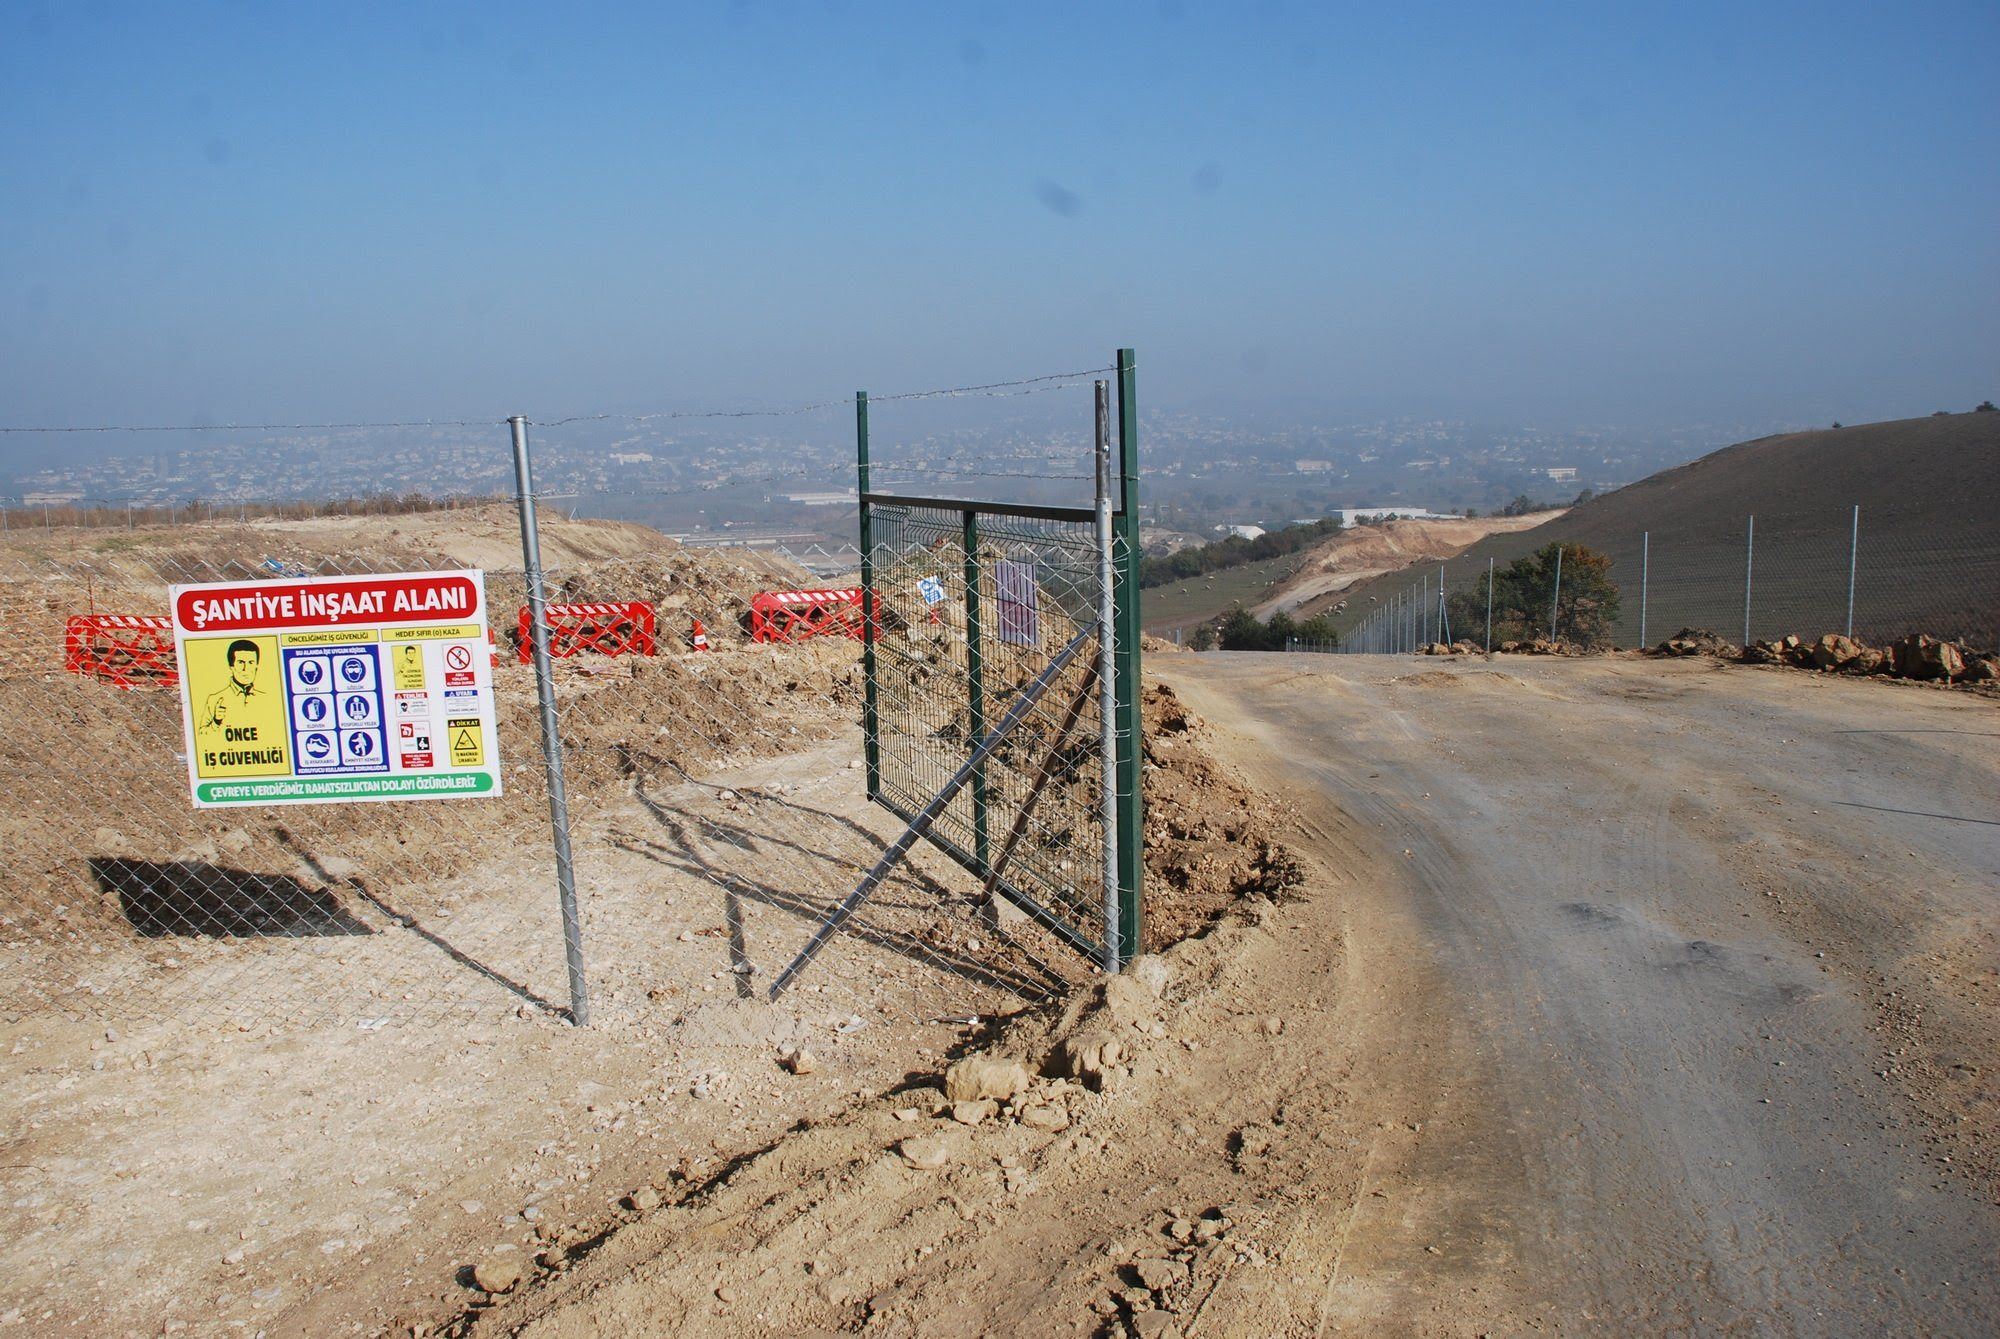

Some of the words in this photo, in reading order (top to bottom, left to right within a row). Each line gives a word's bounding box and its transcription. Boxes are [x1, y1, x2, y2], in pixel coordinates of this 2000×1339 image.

[192, 592, 295, 628] ŞANTİYE
[299, 589, 387, 622] İNŞAAT
[393, 586, 467, 612] ALANI
[395, 630, 415, 638] HEDEF
[443, 628, 460, 636] KAZA
[225, 725, 258, 742] ÖNCE
[205, 749, 217, 770] İŞ
[219, 747, 284, 766] GÜVENLİĞİ
[210, 786, 250, 801] ÇEVREYE
[251, 782, 304, 797] VERDİĞİMİZ
[305, 780, 380, 794] RAHATSIZLIKTAN
[381, 779, 416, 791] DOLAYI
[416, 775, 477, 790] ÖZÜRDİLERİZ
